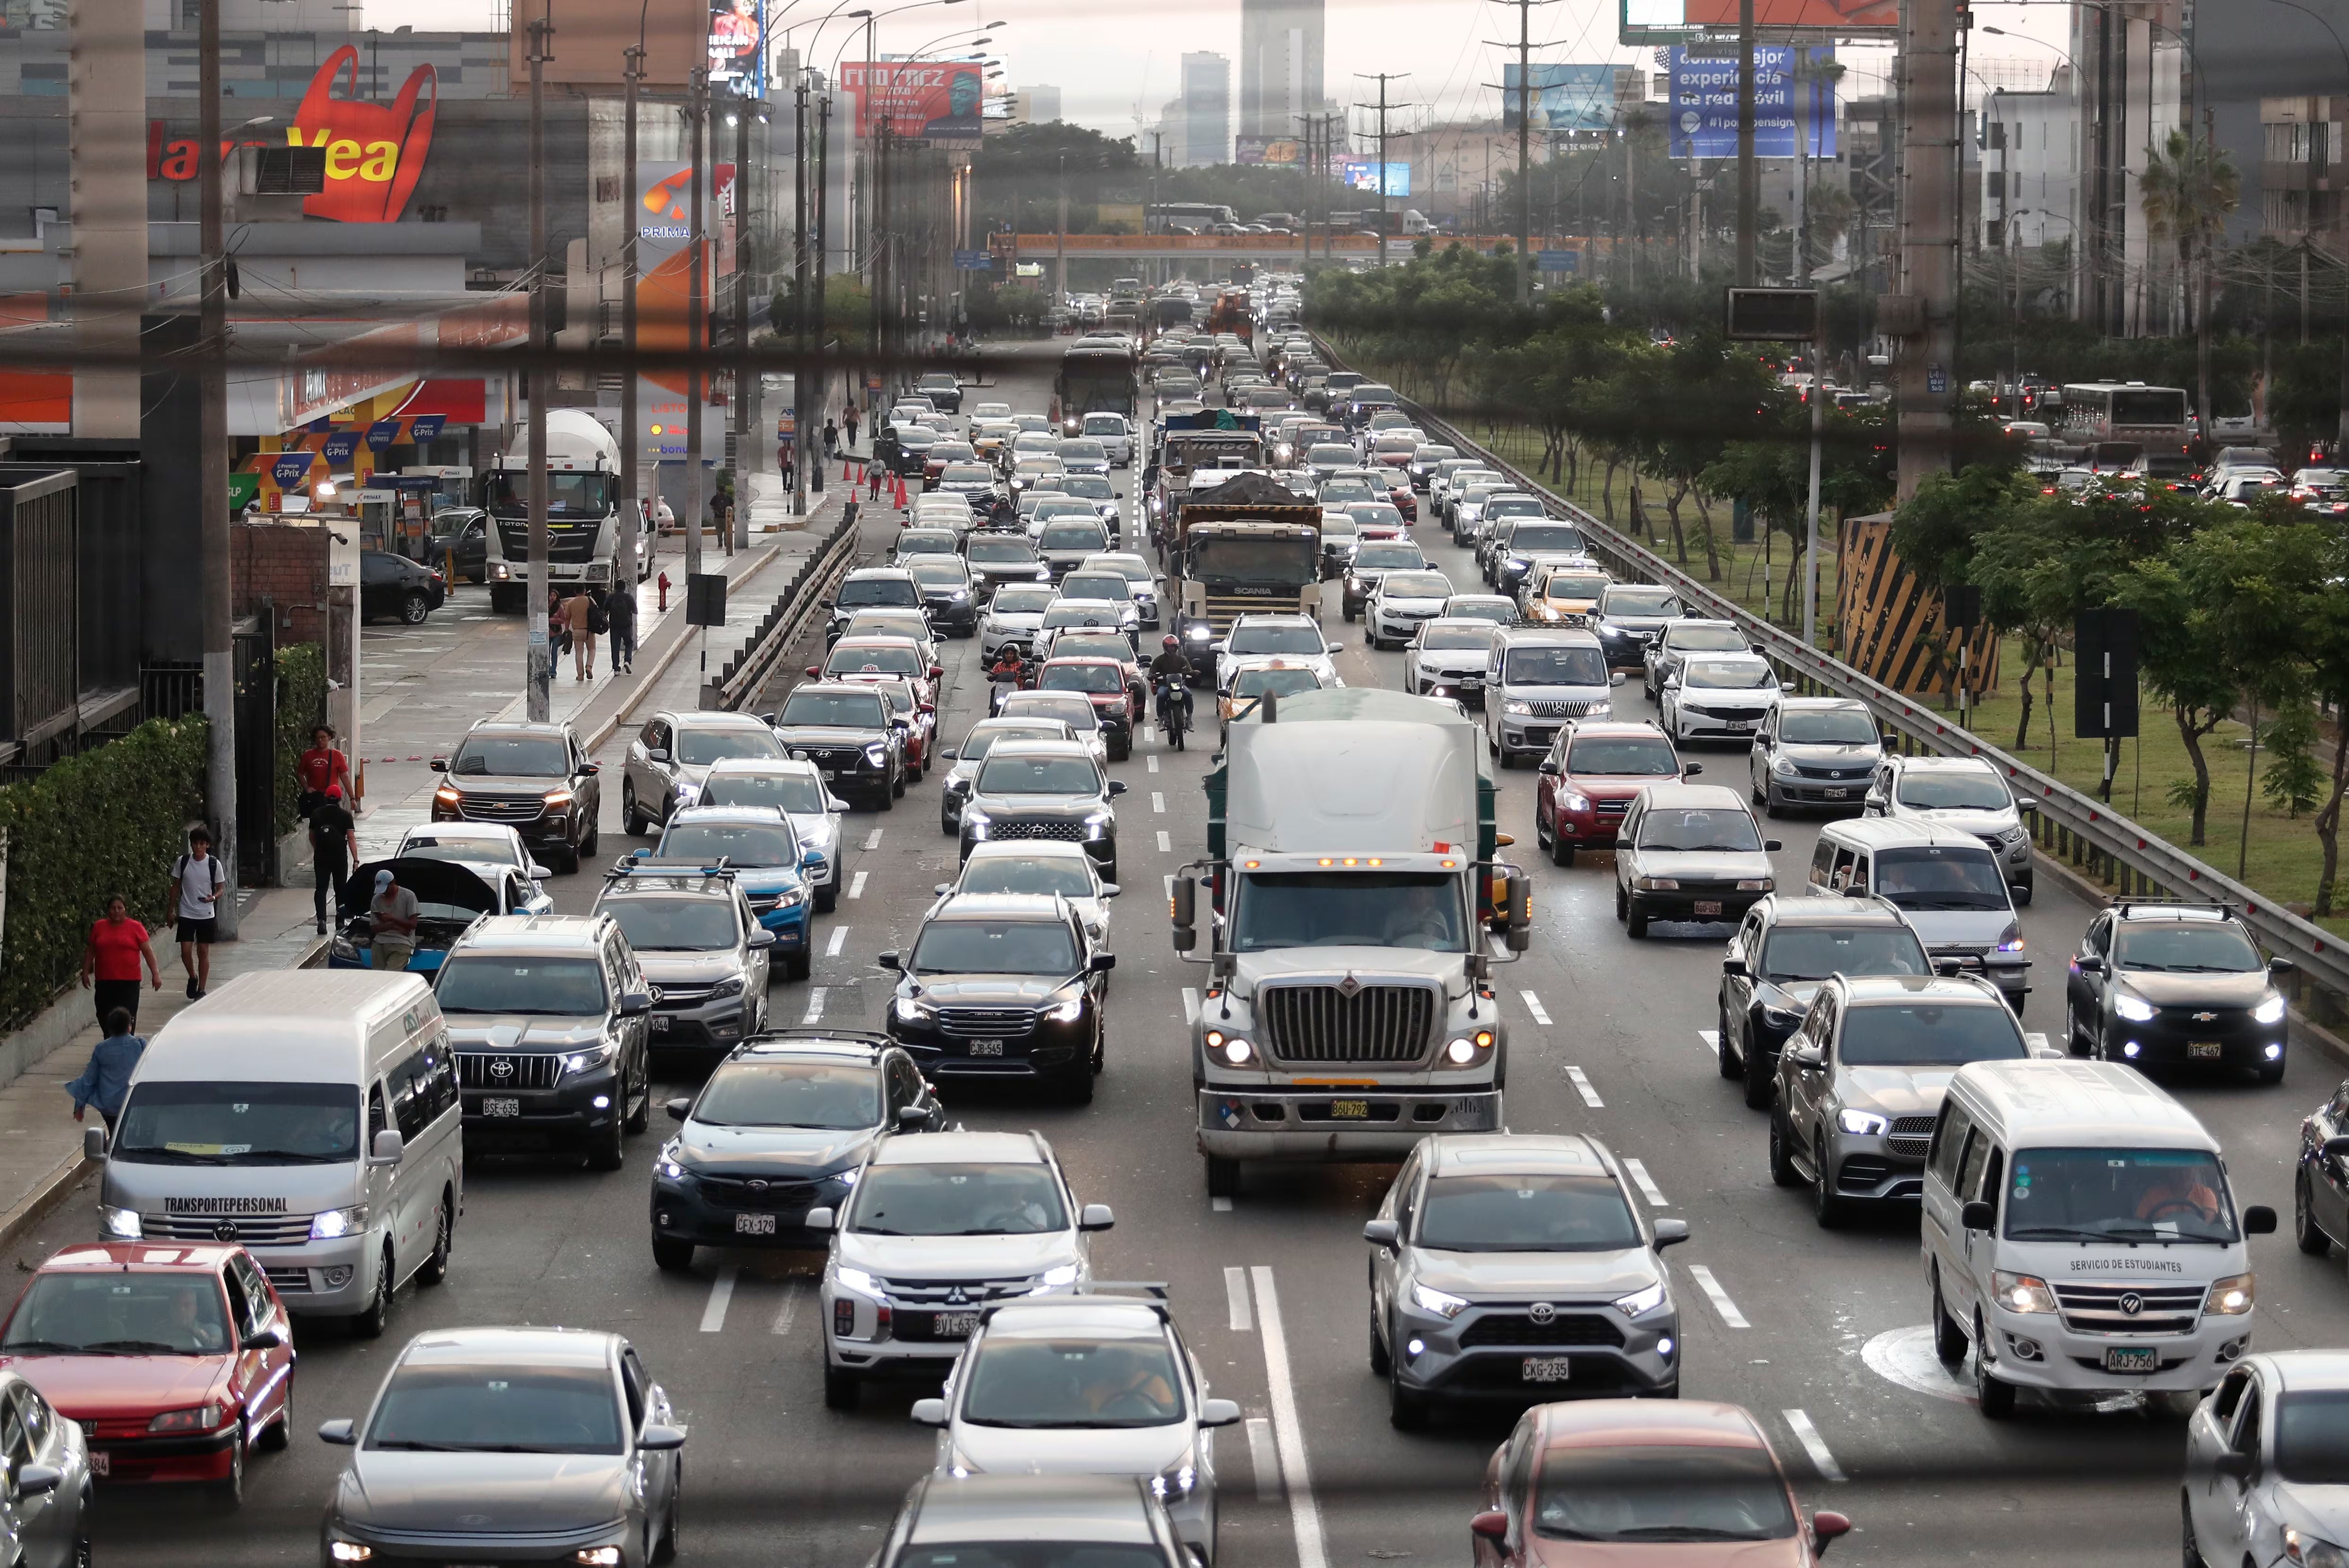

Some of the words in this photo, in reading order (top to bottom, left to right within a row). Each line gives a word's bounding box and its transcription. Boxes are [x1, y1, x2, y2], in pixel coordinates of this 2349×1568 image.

[1705, 91, 1733, 105] red
[327, 448, 348, 456] G-Prix
[277, 469, 299, 478] G-Prix
[971, 1044, 1001, 1054] CJB-545
[2189, 1046, 2219, 1056] BTE-467
[485, 1103, 518, 1113] BSE-635
[1333, 1104, 1367, 1115] B6U-792
[165, 1197, 288, 1213] TRANSPORTEPERSONAL
[2070, 1260, 2109, 1271] SERVICIO
[2112, 1259, 2122, 1269] DE
[2124, 1259, 2181, 1273] ESTUDIANTES
[2110, 1354, 2153, 1367] ARJ-756
[1524, 1364, 1567, 1376] CKG-235
